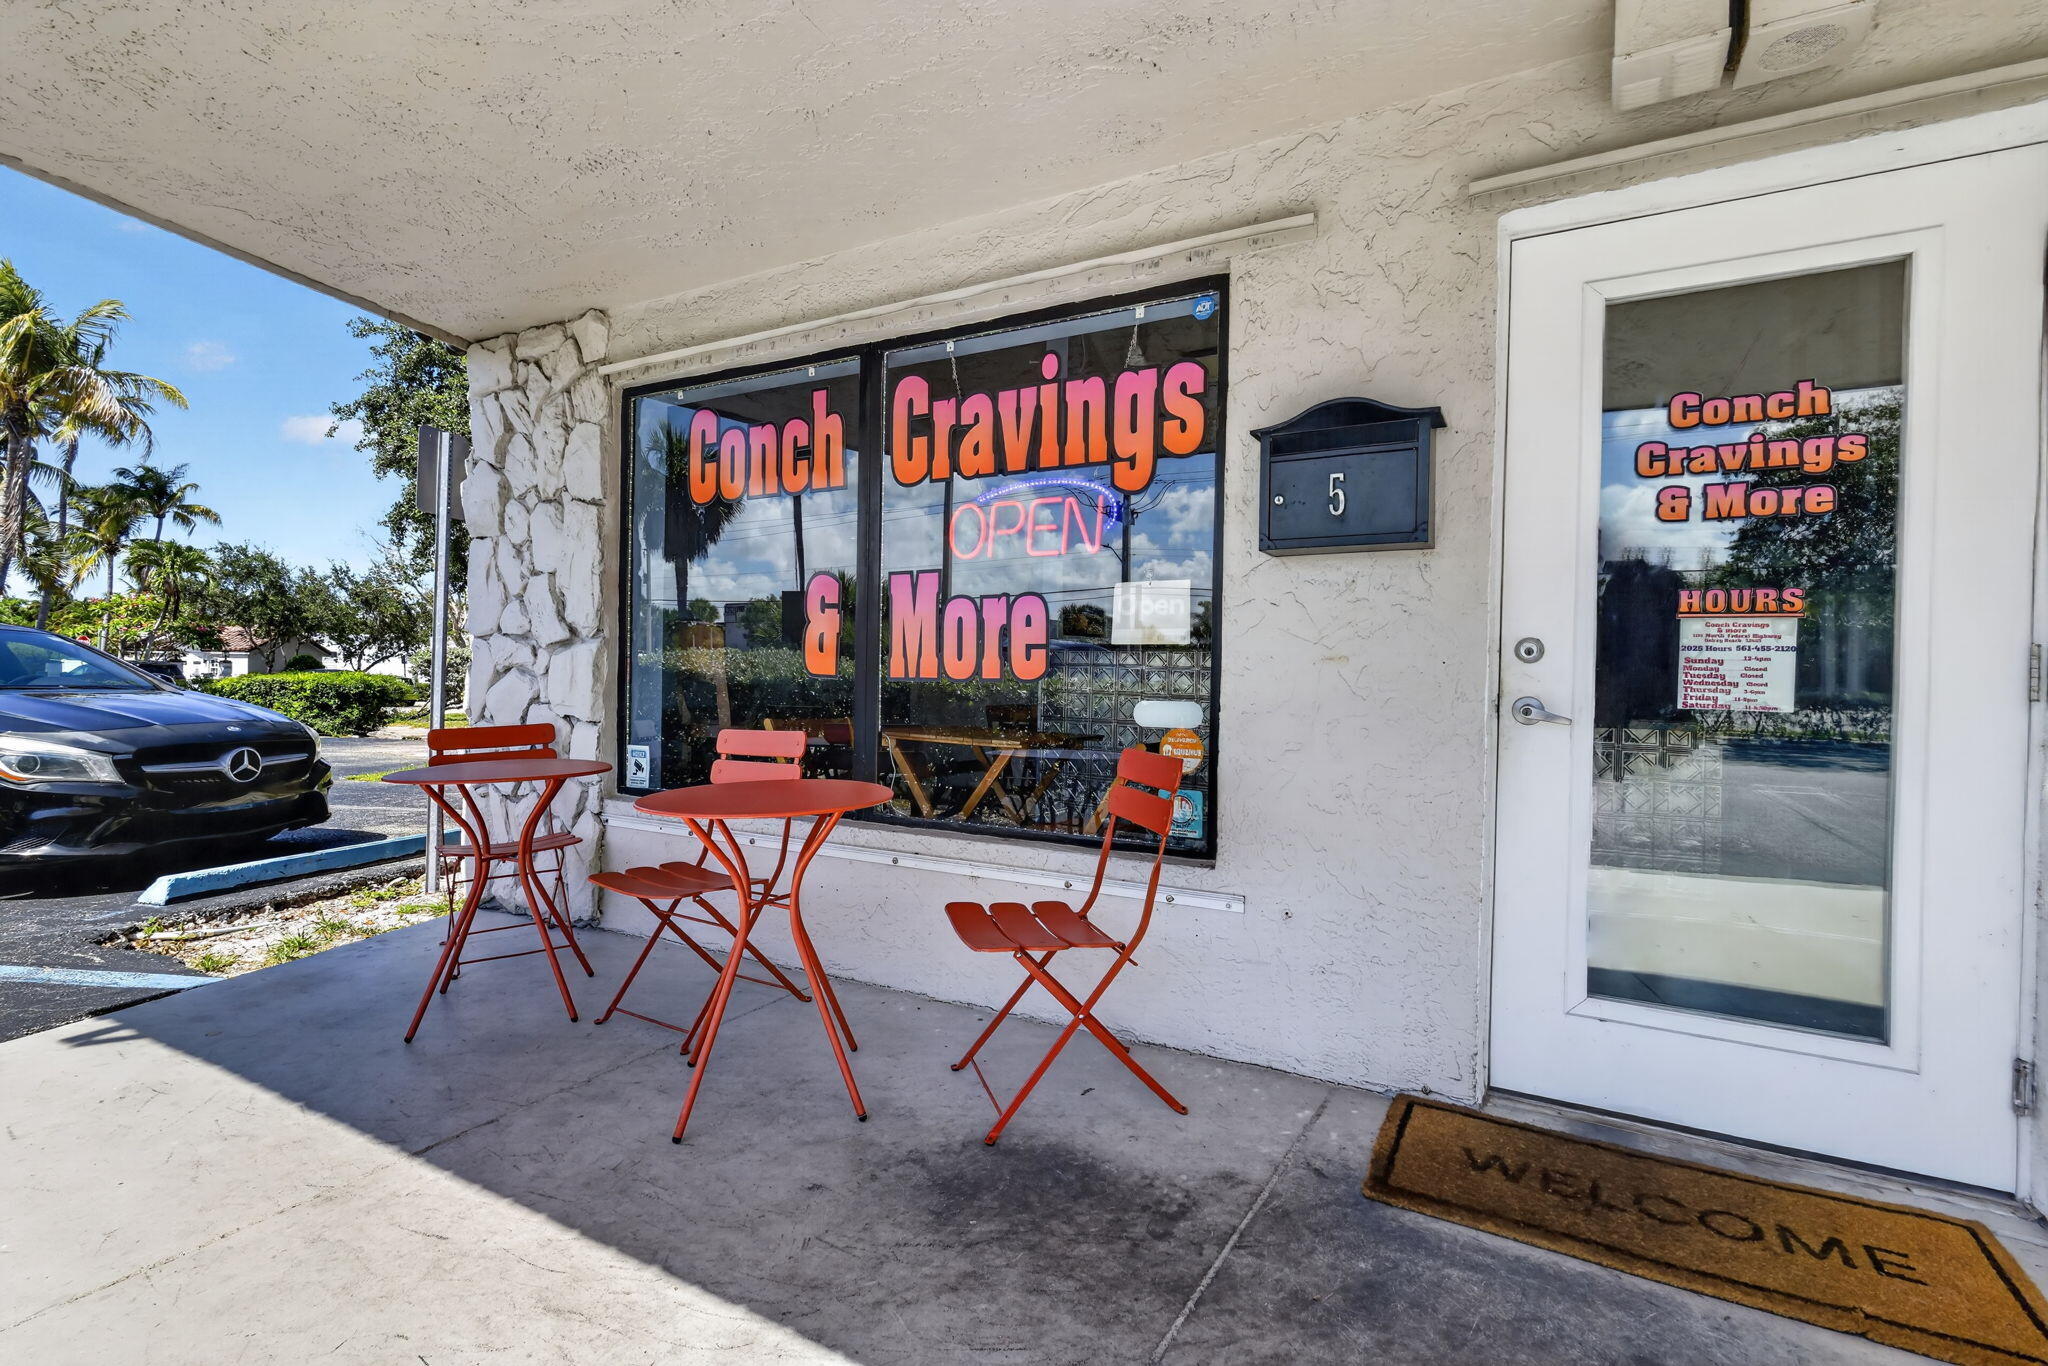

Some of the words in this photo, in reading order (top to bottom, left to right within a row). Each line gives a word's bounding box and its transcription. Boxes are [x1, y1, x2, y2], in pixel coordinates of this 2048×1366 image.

[1668, 378, 1832, 429] Conch
[688, 386, 848, 507] Conch
[890, 350, 1207, 495] Cravings
[1634, 432, 1870, 478] Cravings
[1328, 472, 1346, 516] 5
[1655, 485, 1692, 522] &
[1701, 481, 1838, 520] More
[948, 494, 1105, 560] OPEN
[1679, 588, 1805, 614] HOURS
[802, 571, 844, 679] &
[887, 567, 1050, 682] More
[1732, 621, 1770, 629] Cravings
[1683, 665, 1720, 673] Monday
[1684, 657, 1724, 666] Sunday
[1683, 672, 1726, 680] Tuesday
[1683, 679, 1739, 688] Wednesday
[1683, 686, 1731, 695] Thursday
[1683, 693, 1719, 703] Friday
[1682, 701, 1731, 710] Saturday
[1460, 1145, 1930, 1288] WELCOME
